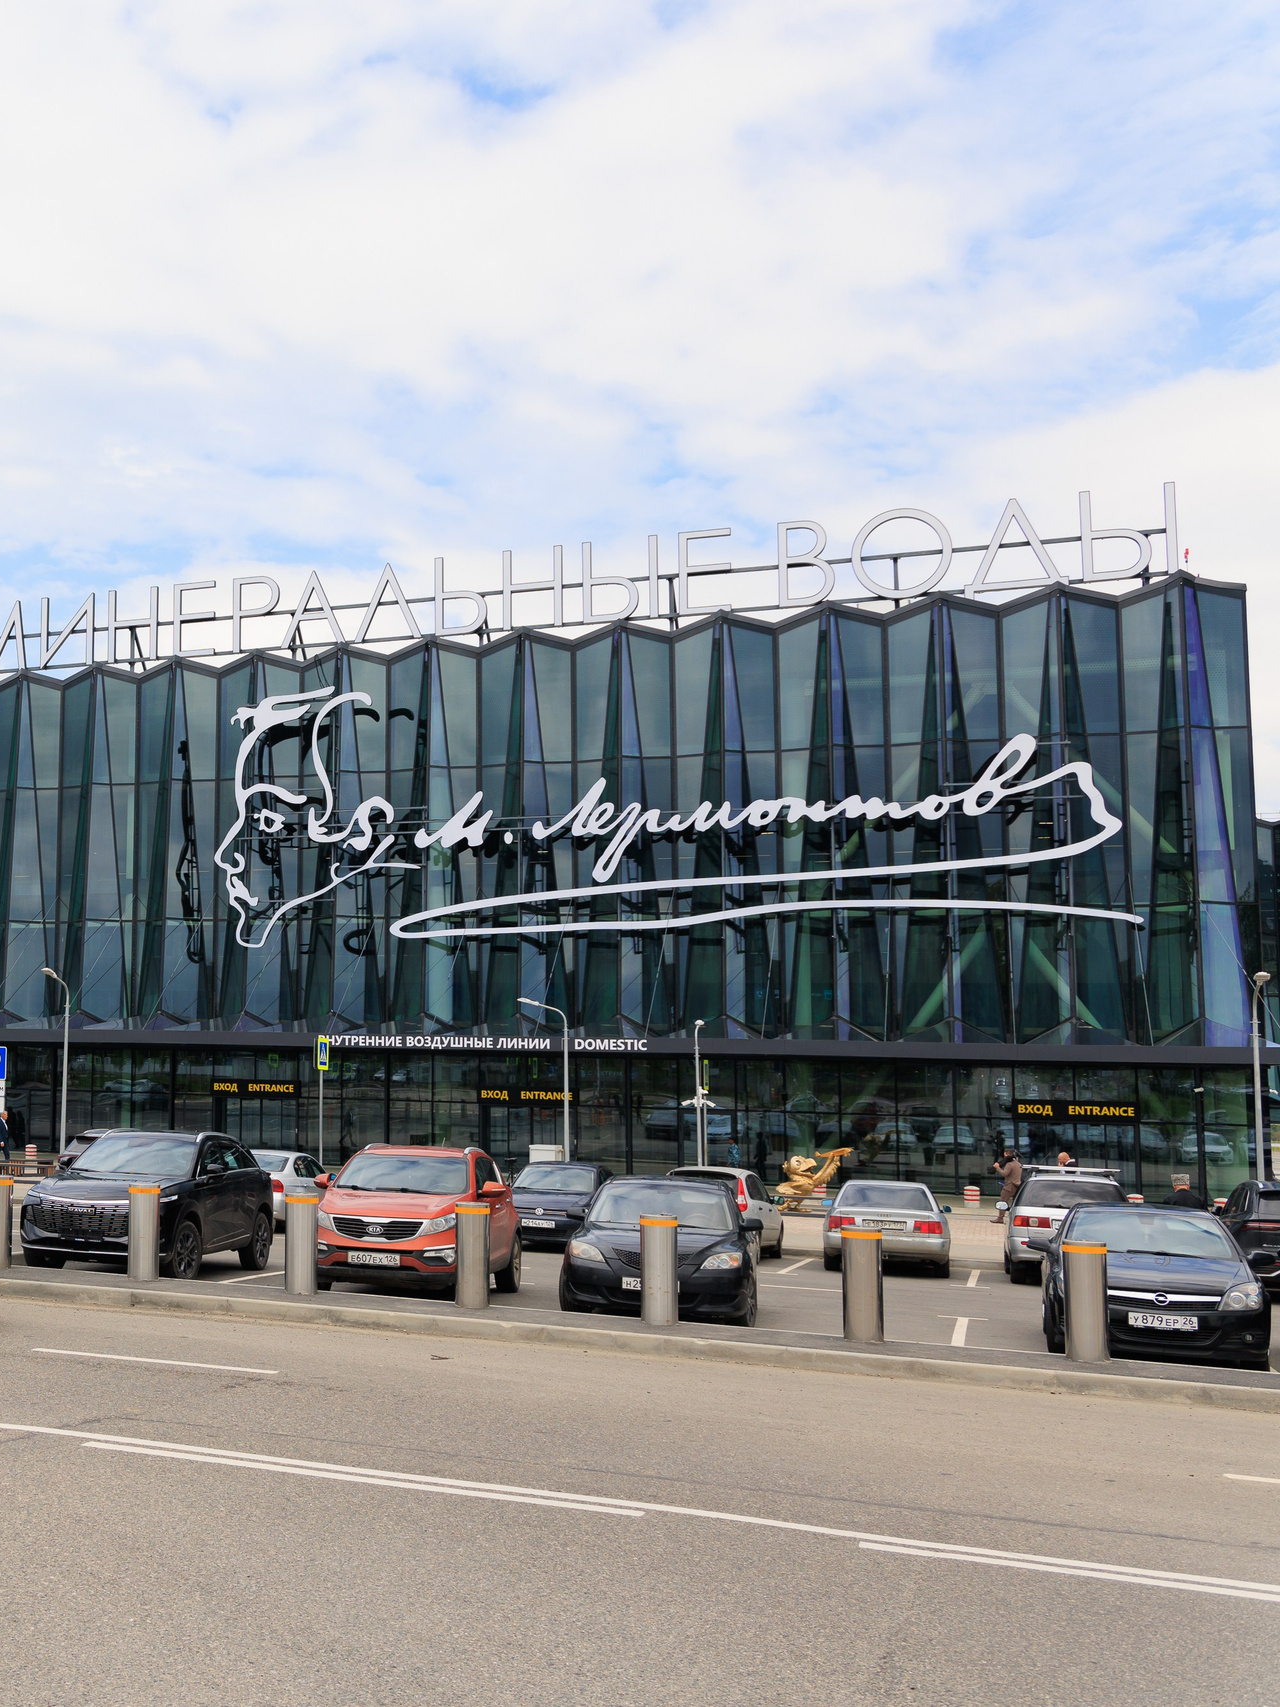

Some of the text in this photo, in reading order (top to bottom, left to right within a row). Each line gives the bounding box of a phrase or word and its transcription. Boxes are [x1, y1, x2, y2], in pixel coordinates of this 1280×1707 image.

[776, 481, 1179, 608] ВОДЫ
[410, 1036, 494, 1049] ВОЗДУШНЫЕ
[496, 1037, 551, 1050] ЛИНИИ
[574, 1038, 648, 1051] DOMESTIC
[213, 1082, 295, 1093] ВХОД ENTRANCE
[480, 1089, 509, 1101] ВХОД
[1017, 1104, 1136, 1117] ВХОД ENTRANCE
